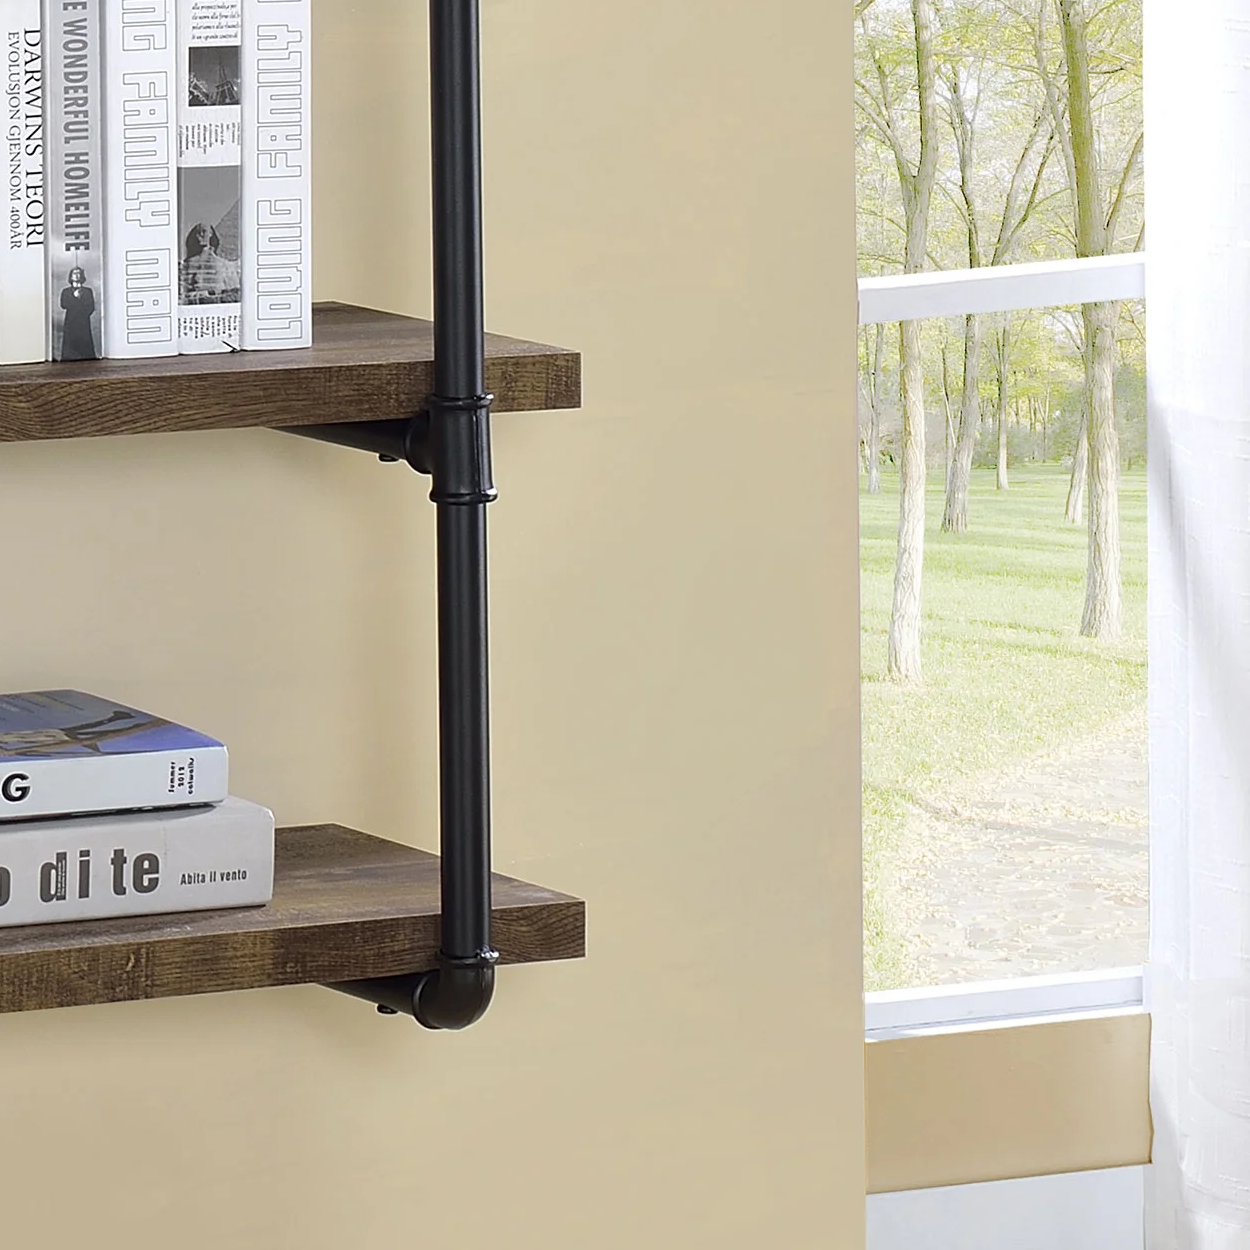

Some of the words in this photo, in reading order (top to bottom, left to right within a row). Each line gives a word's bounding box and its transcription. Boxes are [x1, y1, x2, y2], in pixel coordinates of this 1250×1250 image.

[7, 31, 21, 121] EVOLUSJON
[23, 27, 43, 158] DARWINS
[62, 17, 89, 144] WONDERFUL
[256, 24, 304, 179] FAMILY
[6, 124, 22, 202] GJENNOM
[123, 70, 170, 228] FAMILY
[9, 205, 23, 251] 400ÅR
[25, 163, 45, 249] TEORI
[63, 151, 91, 253] HOMELIFE
[125, 248, 172, 345] MAN
[256, 197, 303, 342] LOVING
[177, 766, 185, 788] 2012
[39, 849, 91, 903] di
[110, 848, 160, 896] te
[180, 872, 206, 886] Abita
[209, 871, 217, 883] il
[219, 869, 248, 883] vento
